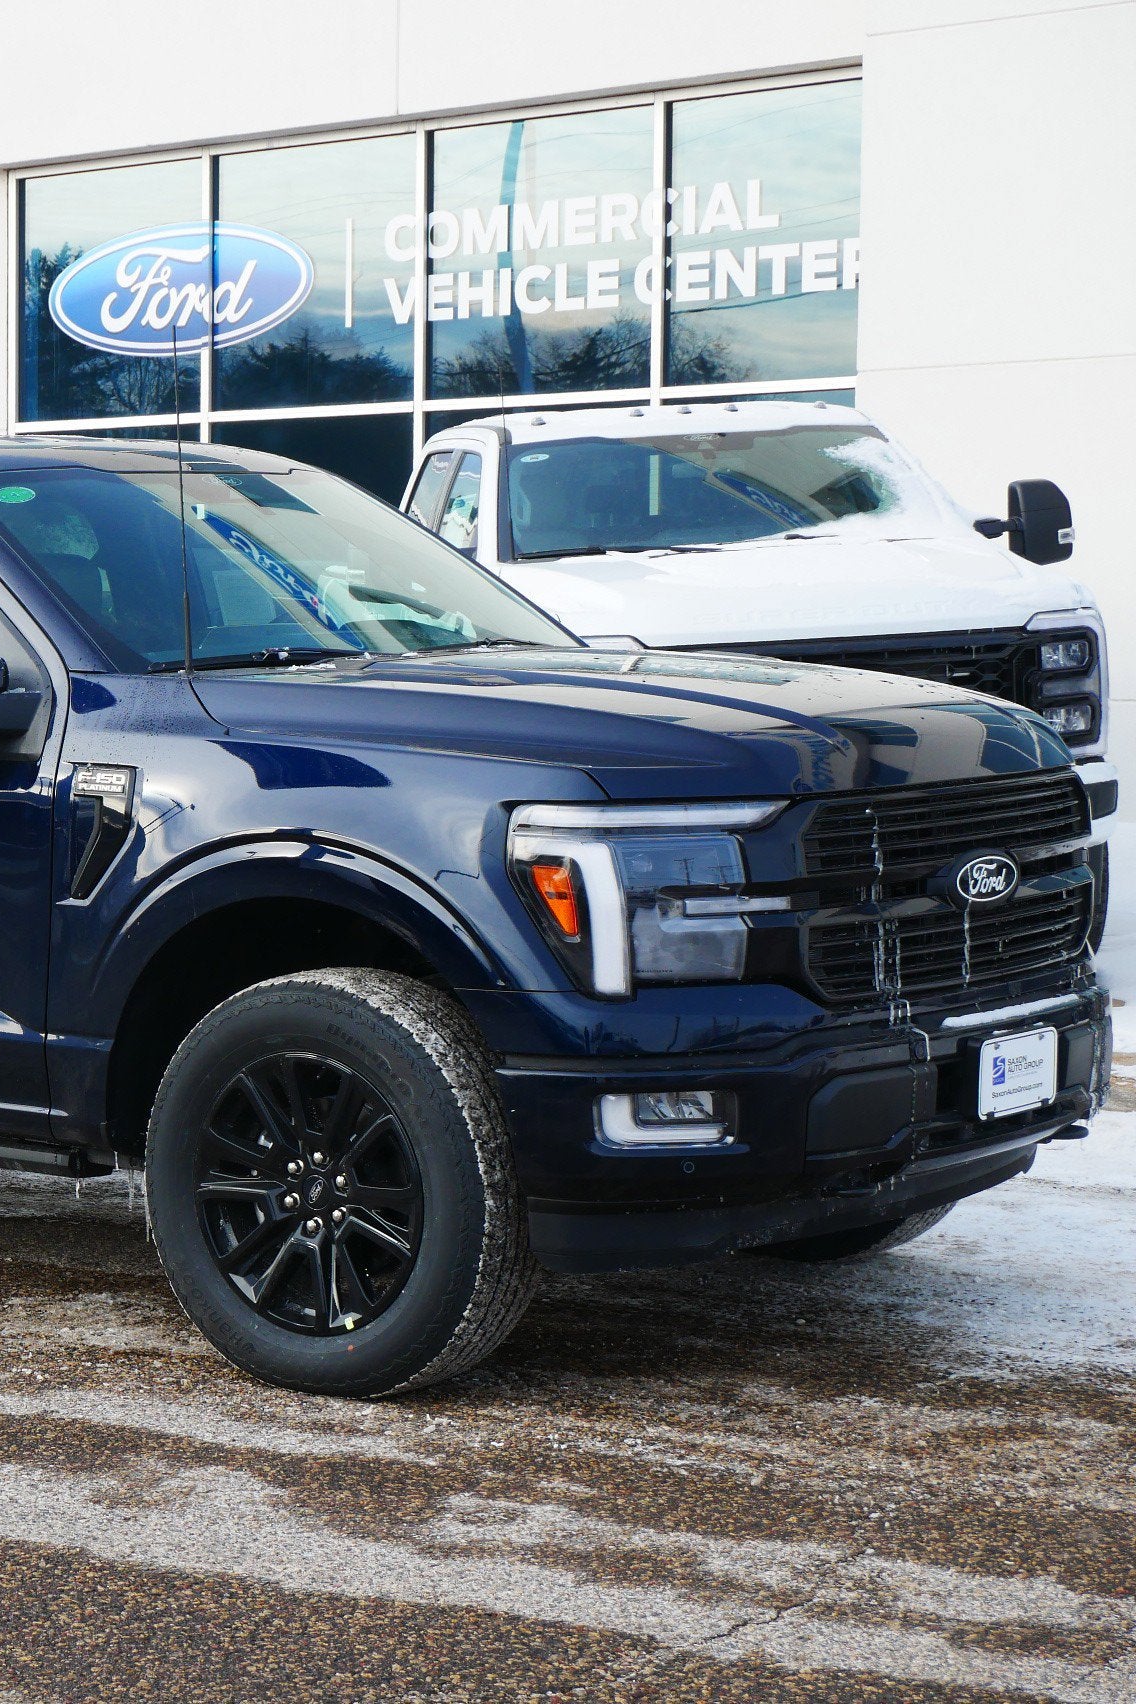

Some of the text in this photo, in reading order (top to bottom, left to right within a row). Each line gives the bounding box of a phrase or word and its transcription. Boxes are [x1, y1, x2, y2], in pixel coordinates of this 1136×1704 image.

[383, 178, 780, 263] COMMERCIAL
[100, 245, 257, 333] Ford
[383, 257, 620, 325] VEHICLE
[78, 783, 123, 792] PLATINUM
[970, 862, 1007, 894] Ford
